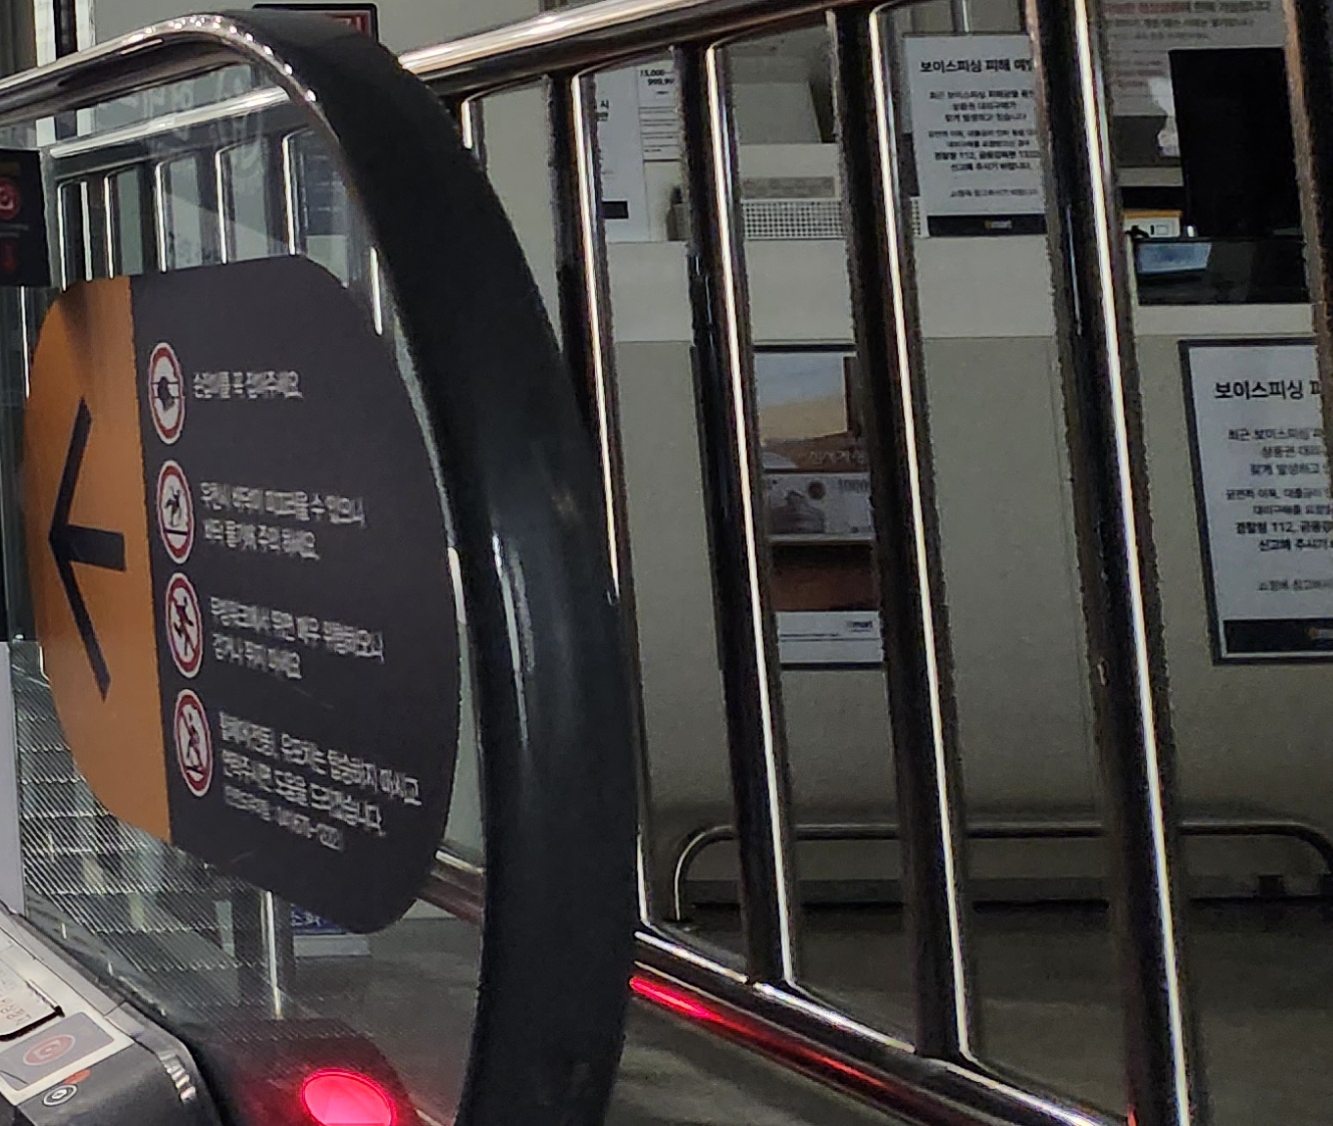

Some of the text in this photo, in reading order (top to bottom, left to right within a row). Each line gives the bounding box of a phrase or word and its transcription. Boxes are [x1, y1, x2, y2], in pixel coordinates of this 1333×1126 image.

[920, 60, 982, 74] 보이스피싱
[985, 59, 1011, 73] 피해
[1215, 381, 1305, 400] 보이스피싱
